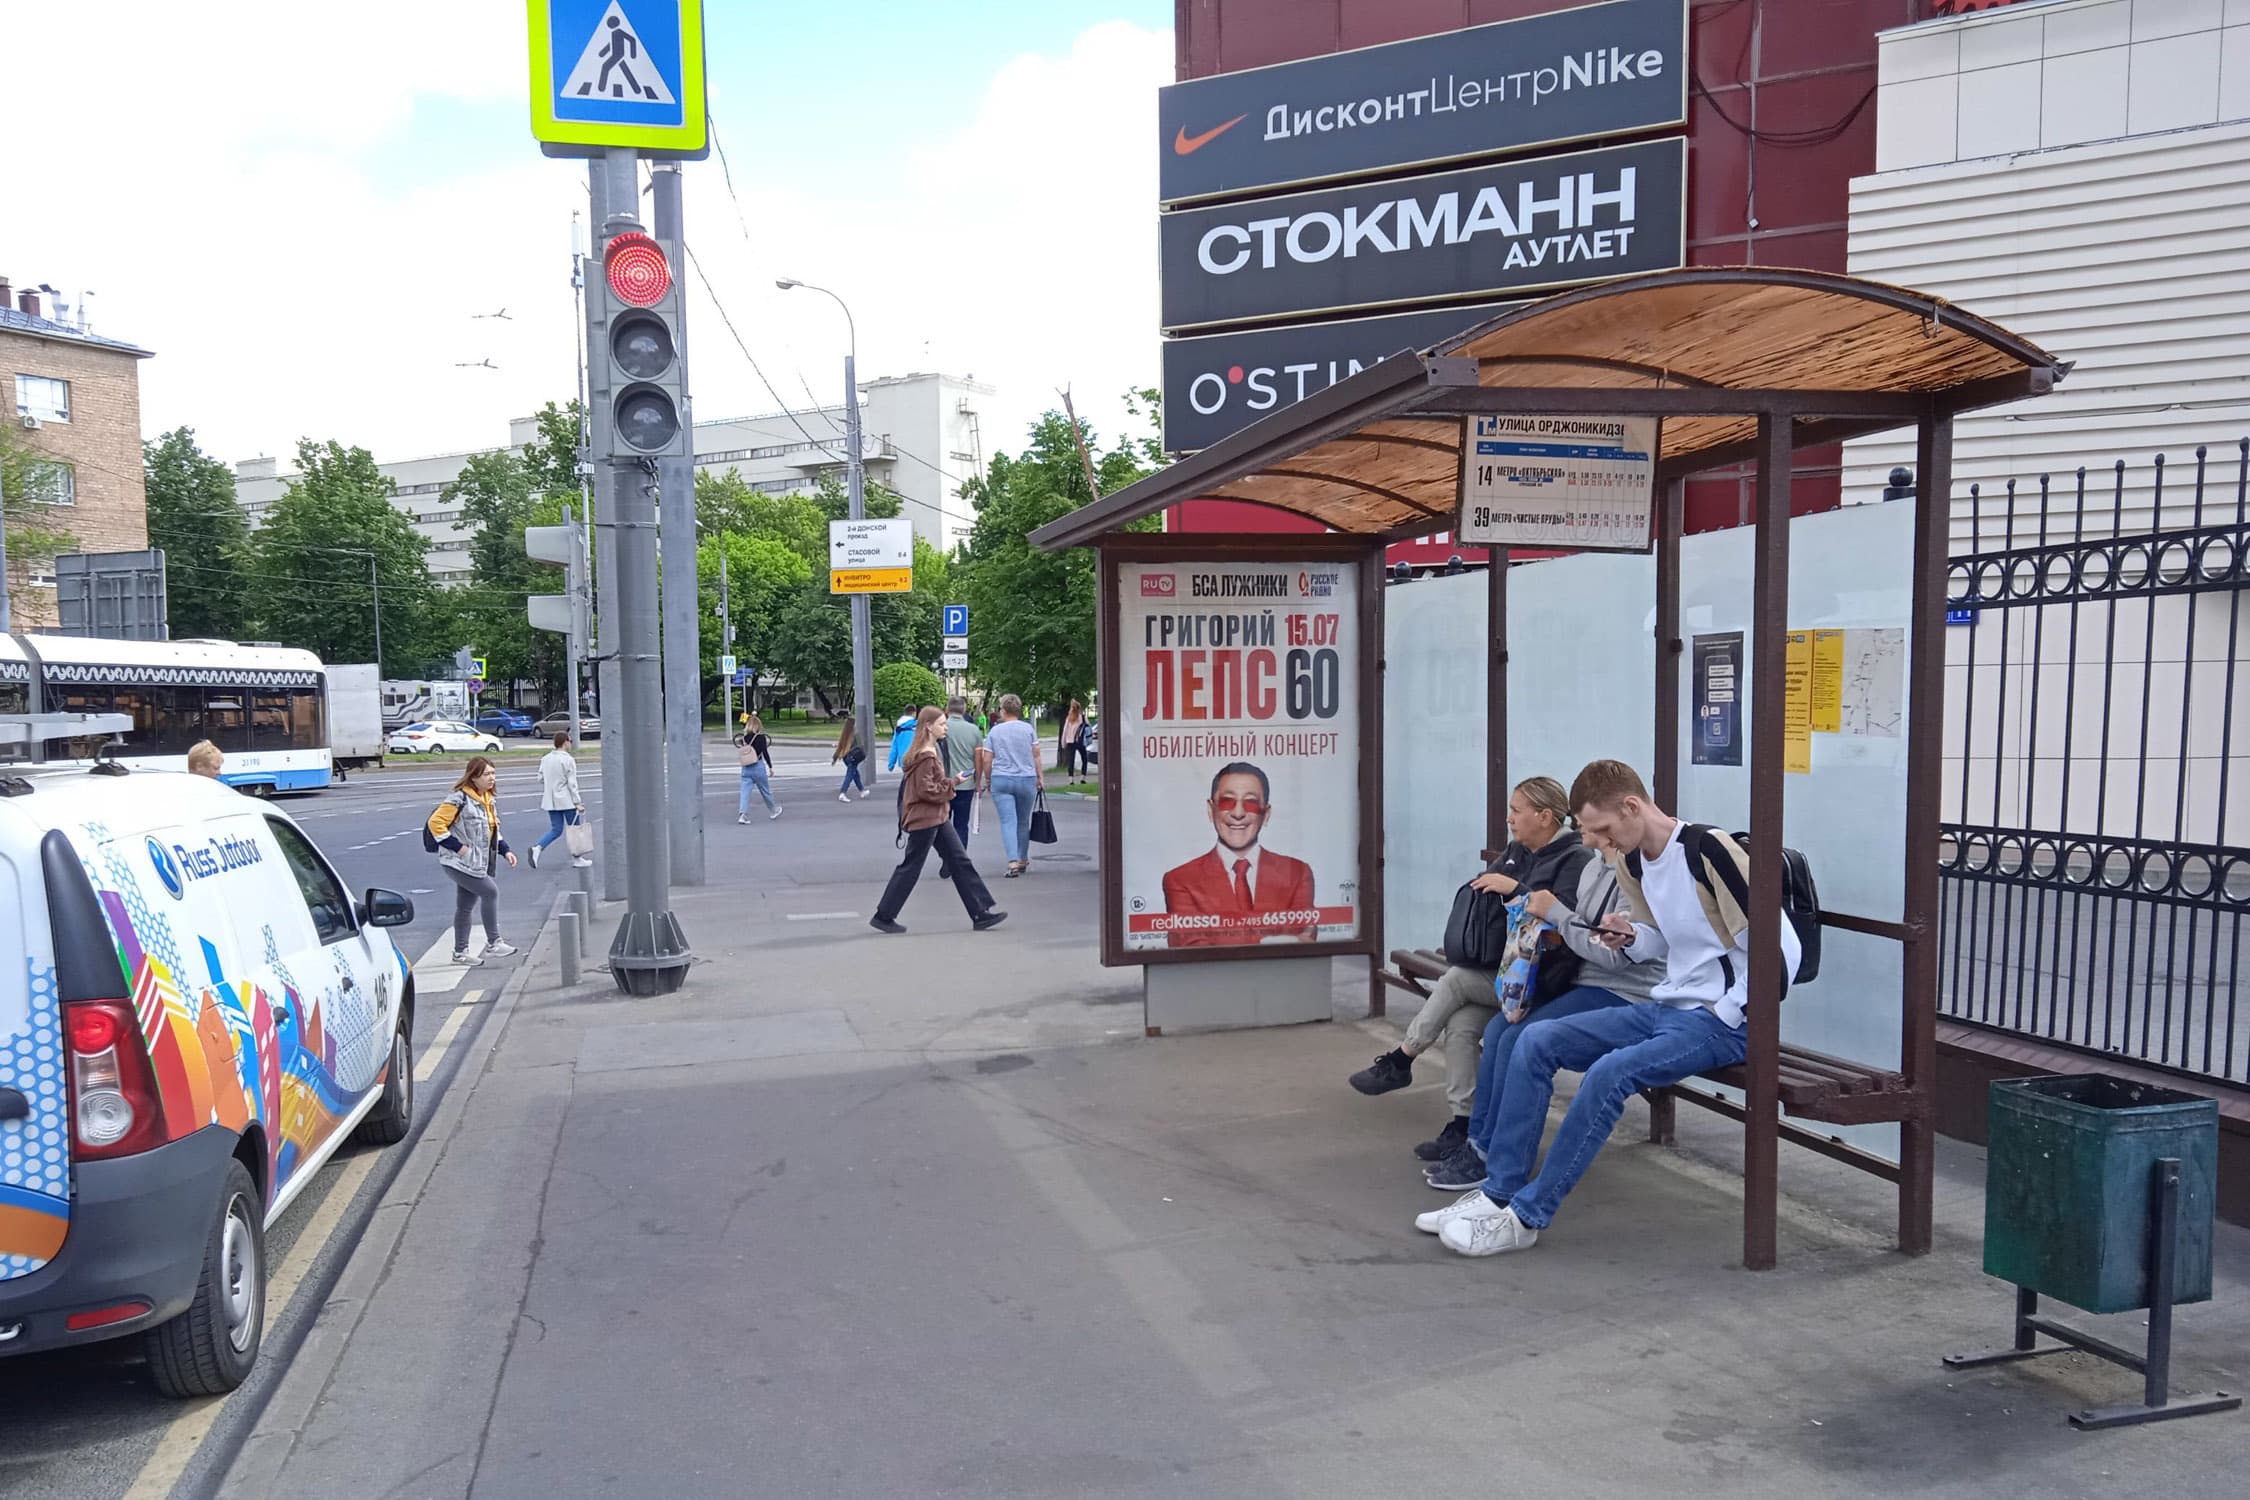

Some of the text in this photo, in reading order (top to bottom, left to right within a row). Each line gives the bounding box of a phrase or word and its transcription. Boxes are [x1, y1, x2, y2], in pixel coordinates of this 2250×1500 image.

[1264, 47, 1663, 141] ДисконтЦентрNike
[1197, 166, 1637, 275] СТОКМАНН
[1502, 227, 1635, 270] АУТЛЕТ
[1498, 418, 1536, 433] УЛИЦА
[1478, 465, 1493, 486] 14
[1497, 466, 1518, 476] МЕТРО
[1474, 506, 1490, 527] 39
[1491, 513, 1512, 523] МЕТРО
[848, 548, 880, 556] СТАСОВОЙ
[1192, 574, 1288, 597] БСА ЛУЖНИКИ
[1145, 609, 1339, 647] ГРИГОРИЙ 15.07
[1142, 648, 1339, 721] ЛЕПС 60
[1143, 731, 1339, 759] ЮБИЛЕЙНЫЙ КОНЦЕРТ
[172, 833, 263, 882] Russ Outdoor
[1151, 914, 1234, 930] redkassa.ru
